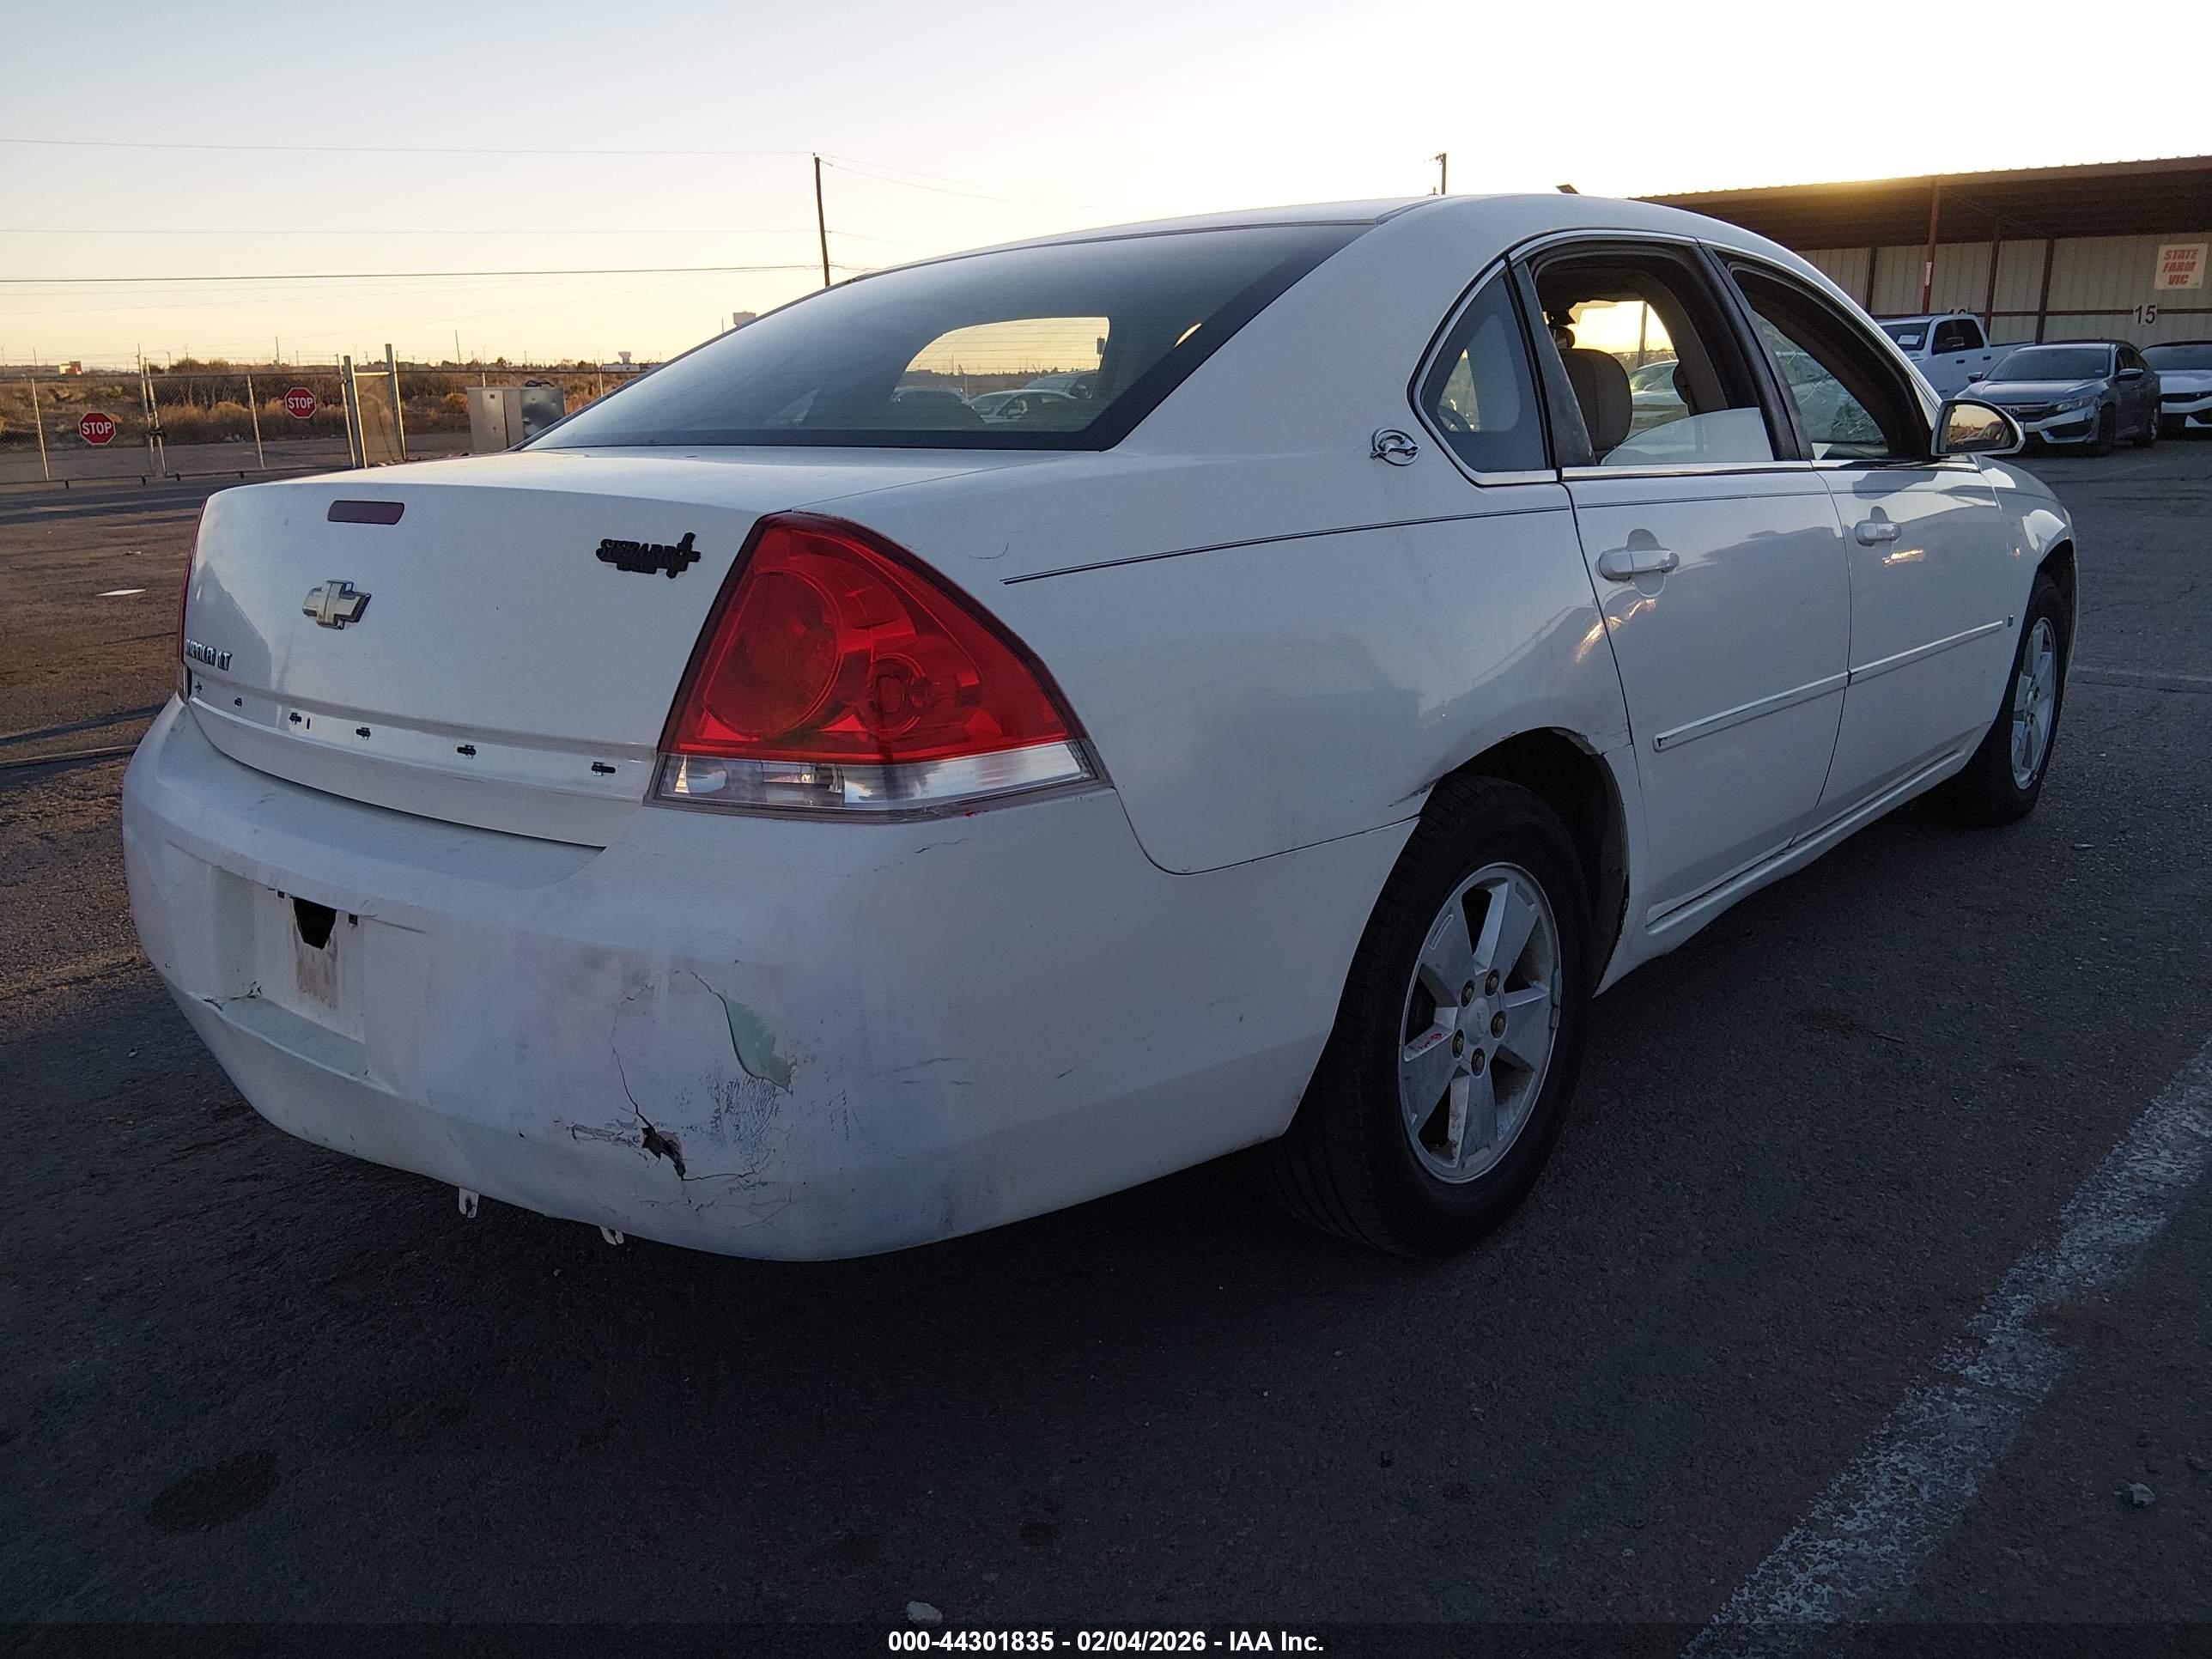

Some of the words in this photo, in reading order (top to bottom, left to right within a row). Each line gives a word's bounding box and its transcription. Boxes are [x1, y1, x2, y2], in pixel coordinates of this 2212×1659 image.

[2164, 249, 2199, 260] STATE
[2162, 261, 2196, 272] FARM
[2168, 275, 2189, 285] VIC
[2135, 305, 2156, 324] 15
[288, 397, 313, 410] STOP
[82, 422, 112, 435] STOP
[218, 652, 232, 671] LT
